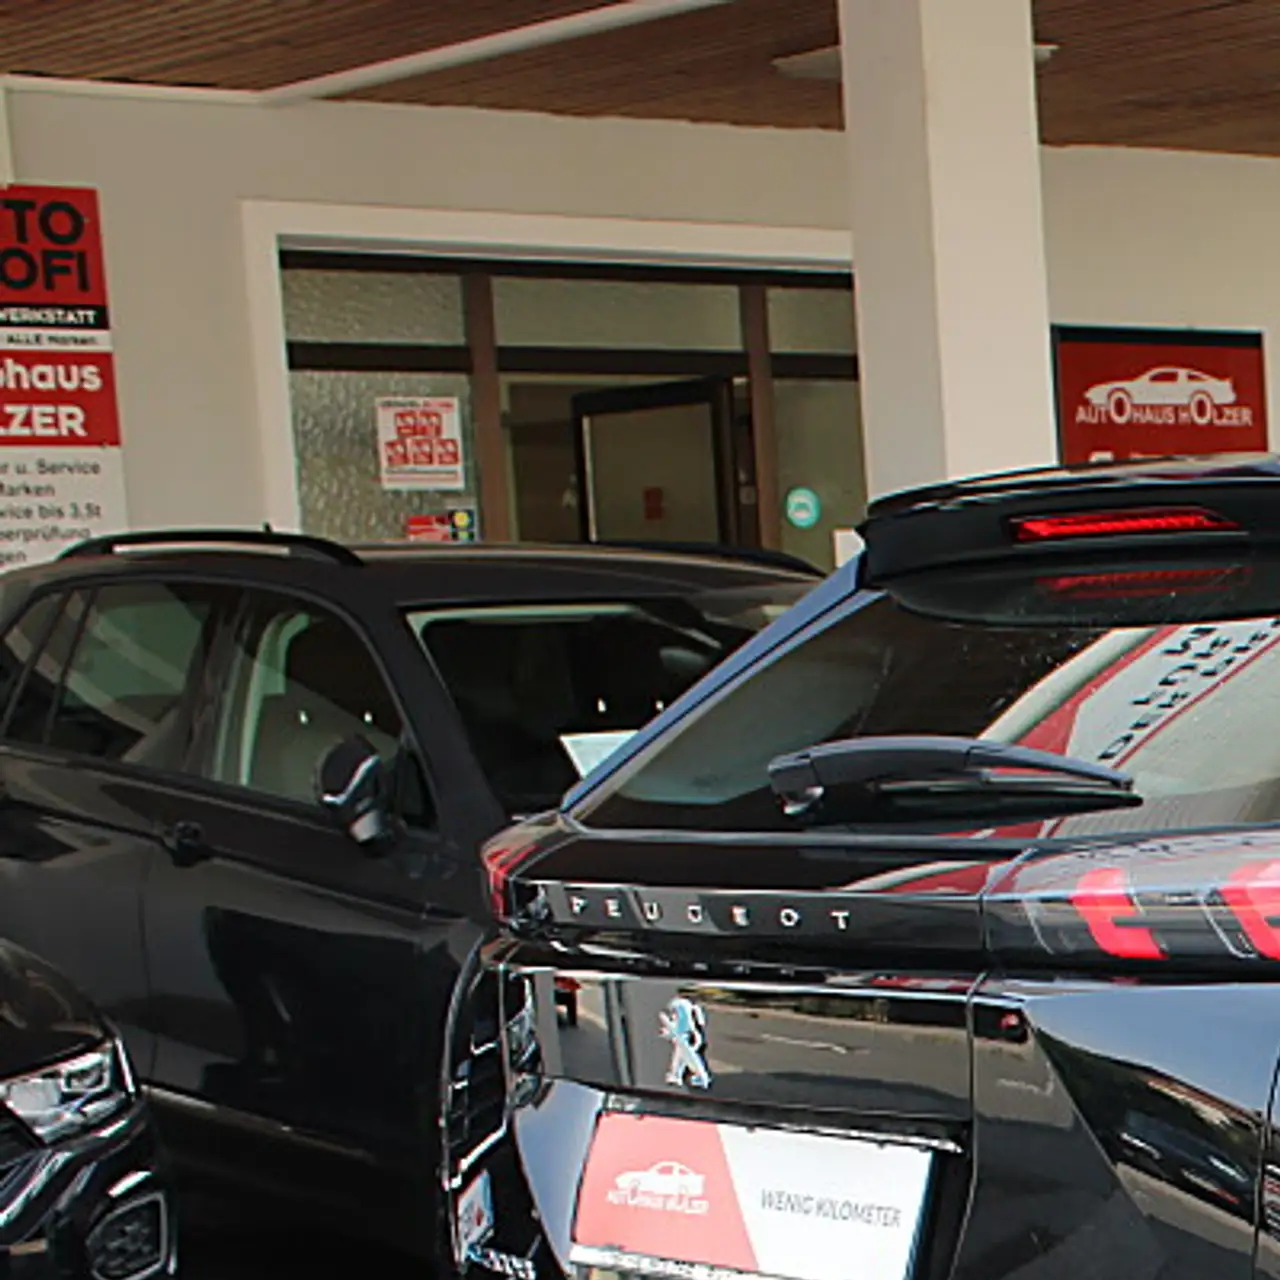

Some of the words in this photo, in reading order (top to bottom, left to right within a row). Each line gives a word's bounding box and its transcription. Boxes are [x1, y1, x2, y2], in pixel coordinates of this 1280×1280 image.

[2, 199, 85, 245] TO
[0, 247, 90, 292] OFI
[0, 358, 103, 392] haus
[0, 403, 88, 437] ZER
[36, 457, 100, 476] Service
[570, 895, 850, 931] PEUGEOT
[760, 1188, 815, 1215] WENIG
[815, 1198, 902, 1228] KILOMETER
